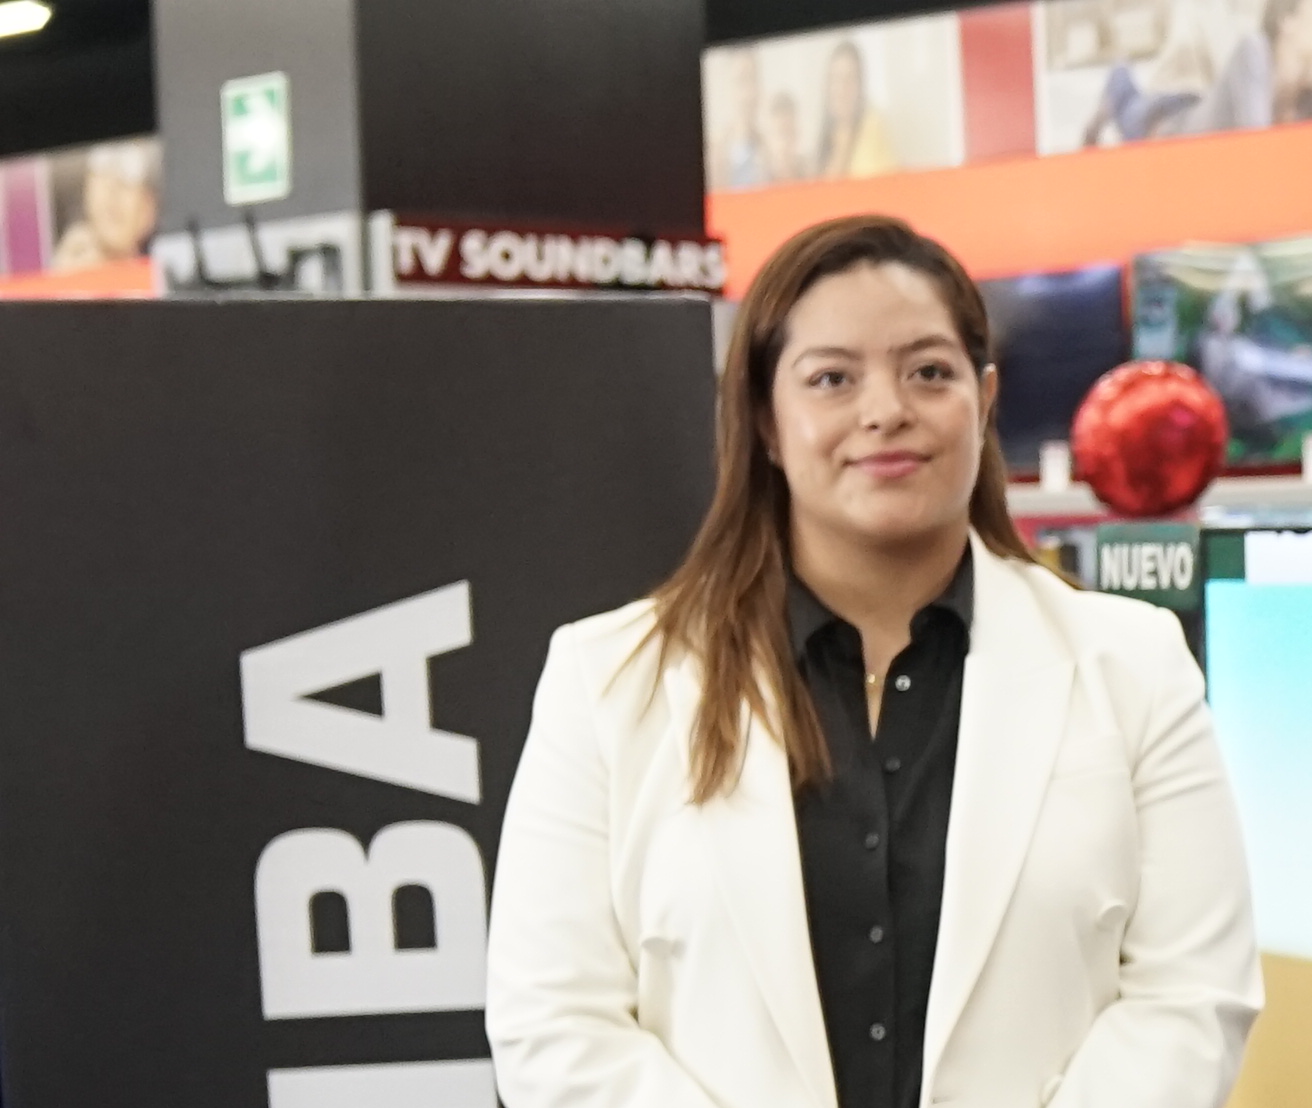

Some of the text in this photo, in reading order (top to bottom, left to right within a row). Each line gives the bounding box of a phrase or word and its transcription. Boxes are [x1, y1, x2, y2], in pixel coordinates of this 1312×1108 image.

[395, 226, 724, 289] TV SOUNDBARS
[1100, 541, 1194, 591] NUEVO
